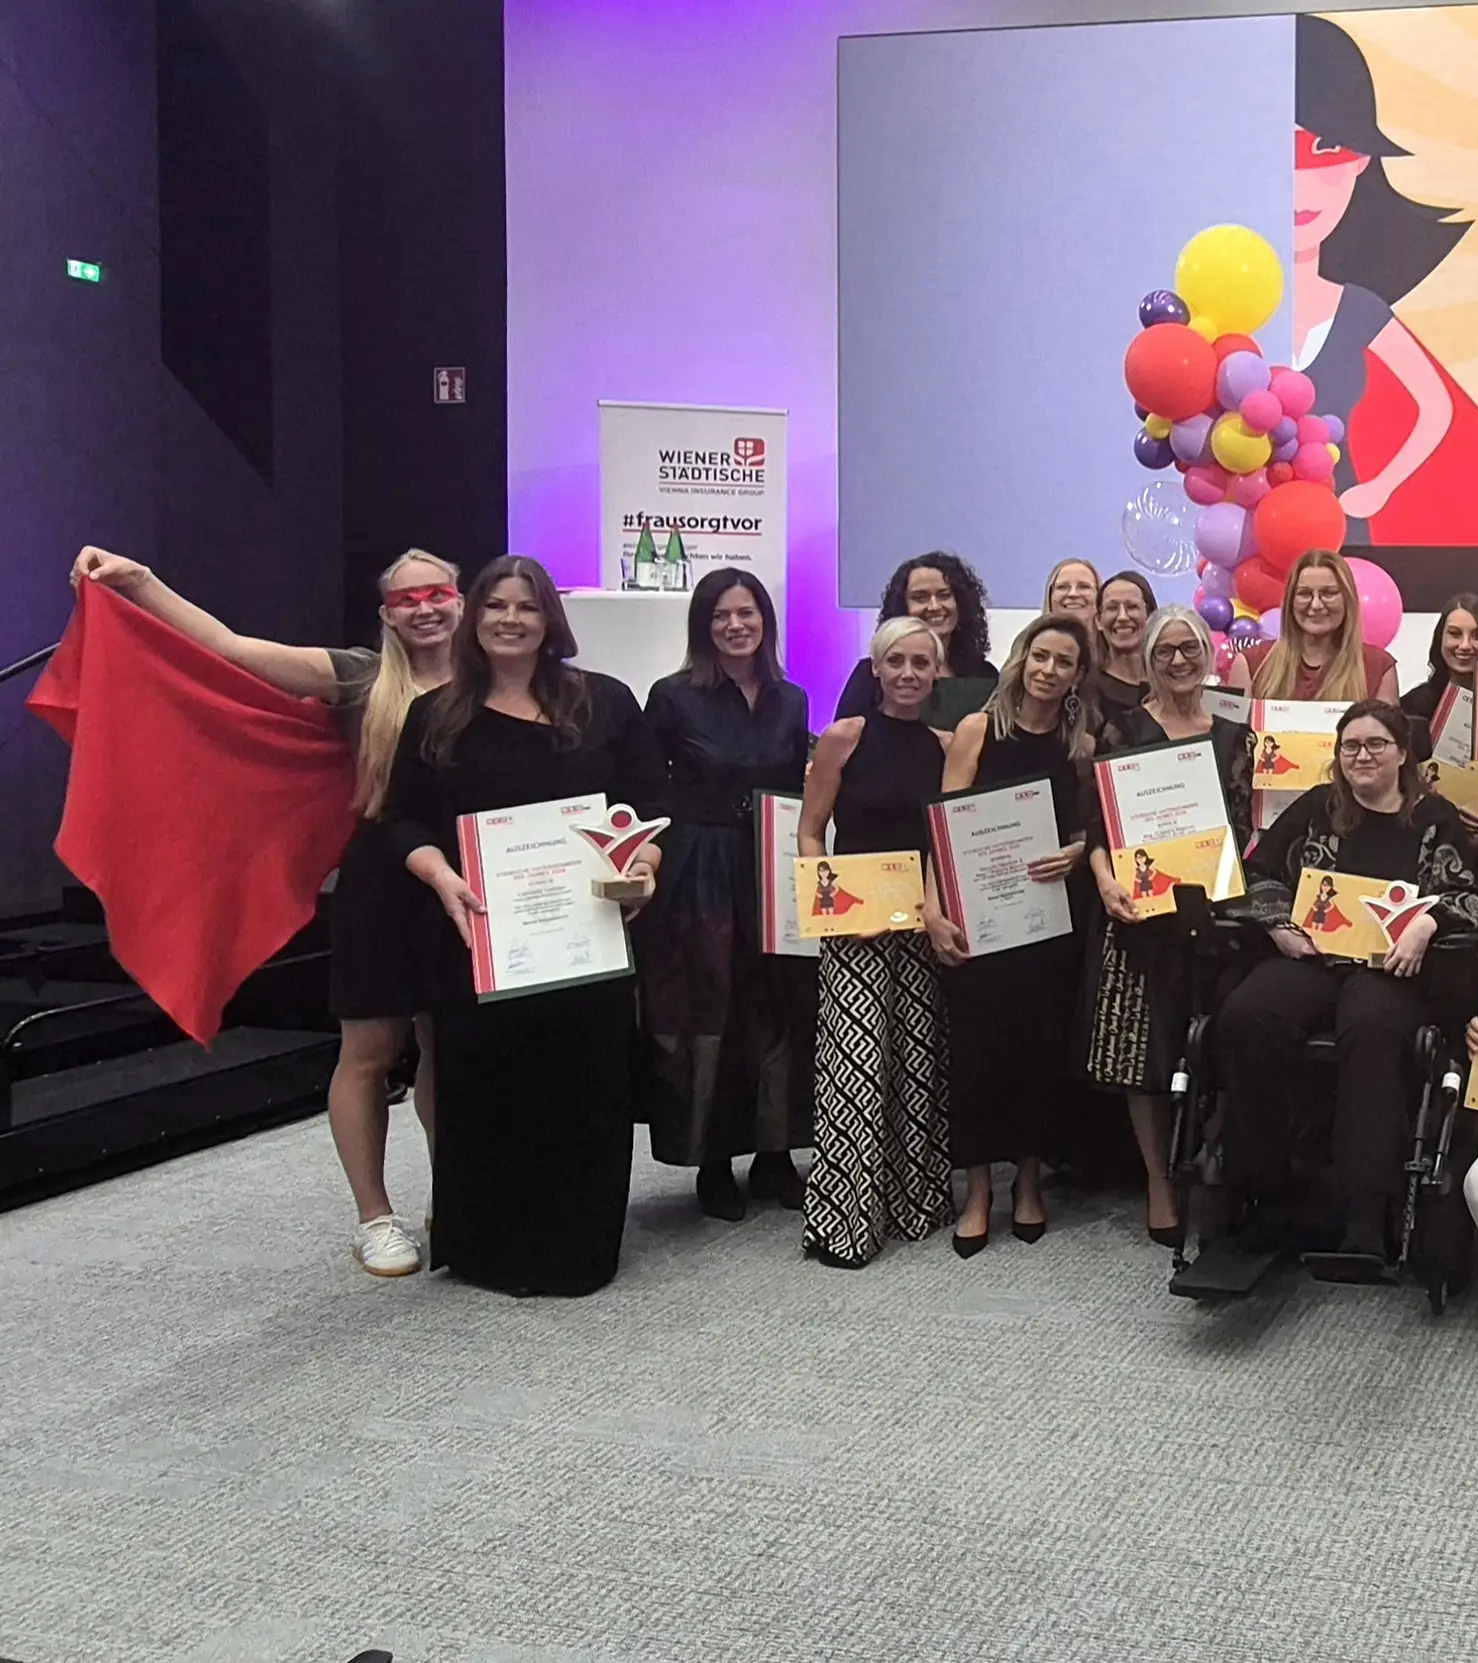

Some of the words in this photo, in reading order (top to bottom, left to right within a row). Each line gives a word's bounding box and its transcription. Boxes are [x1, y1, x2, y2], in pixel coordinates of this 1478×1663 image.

[659, 450, 731, 466] WIENER
[659, 465, 765, 483] STÄDTISCHE
[623, 511, 762, 534] #frausorgtvor
